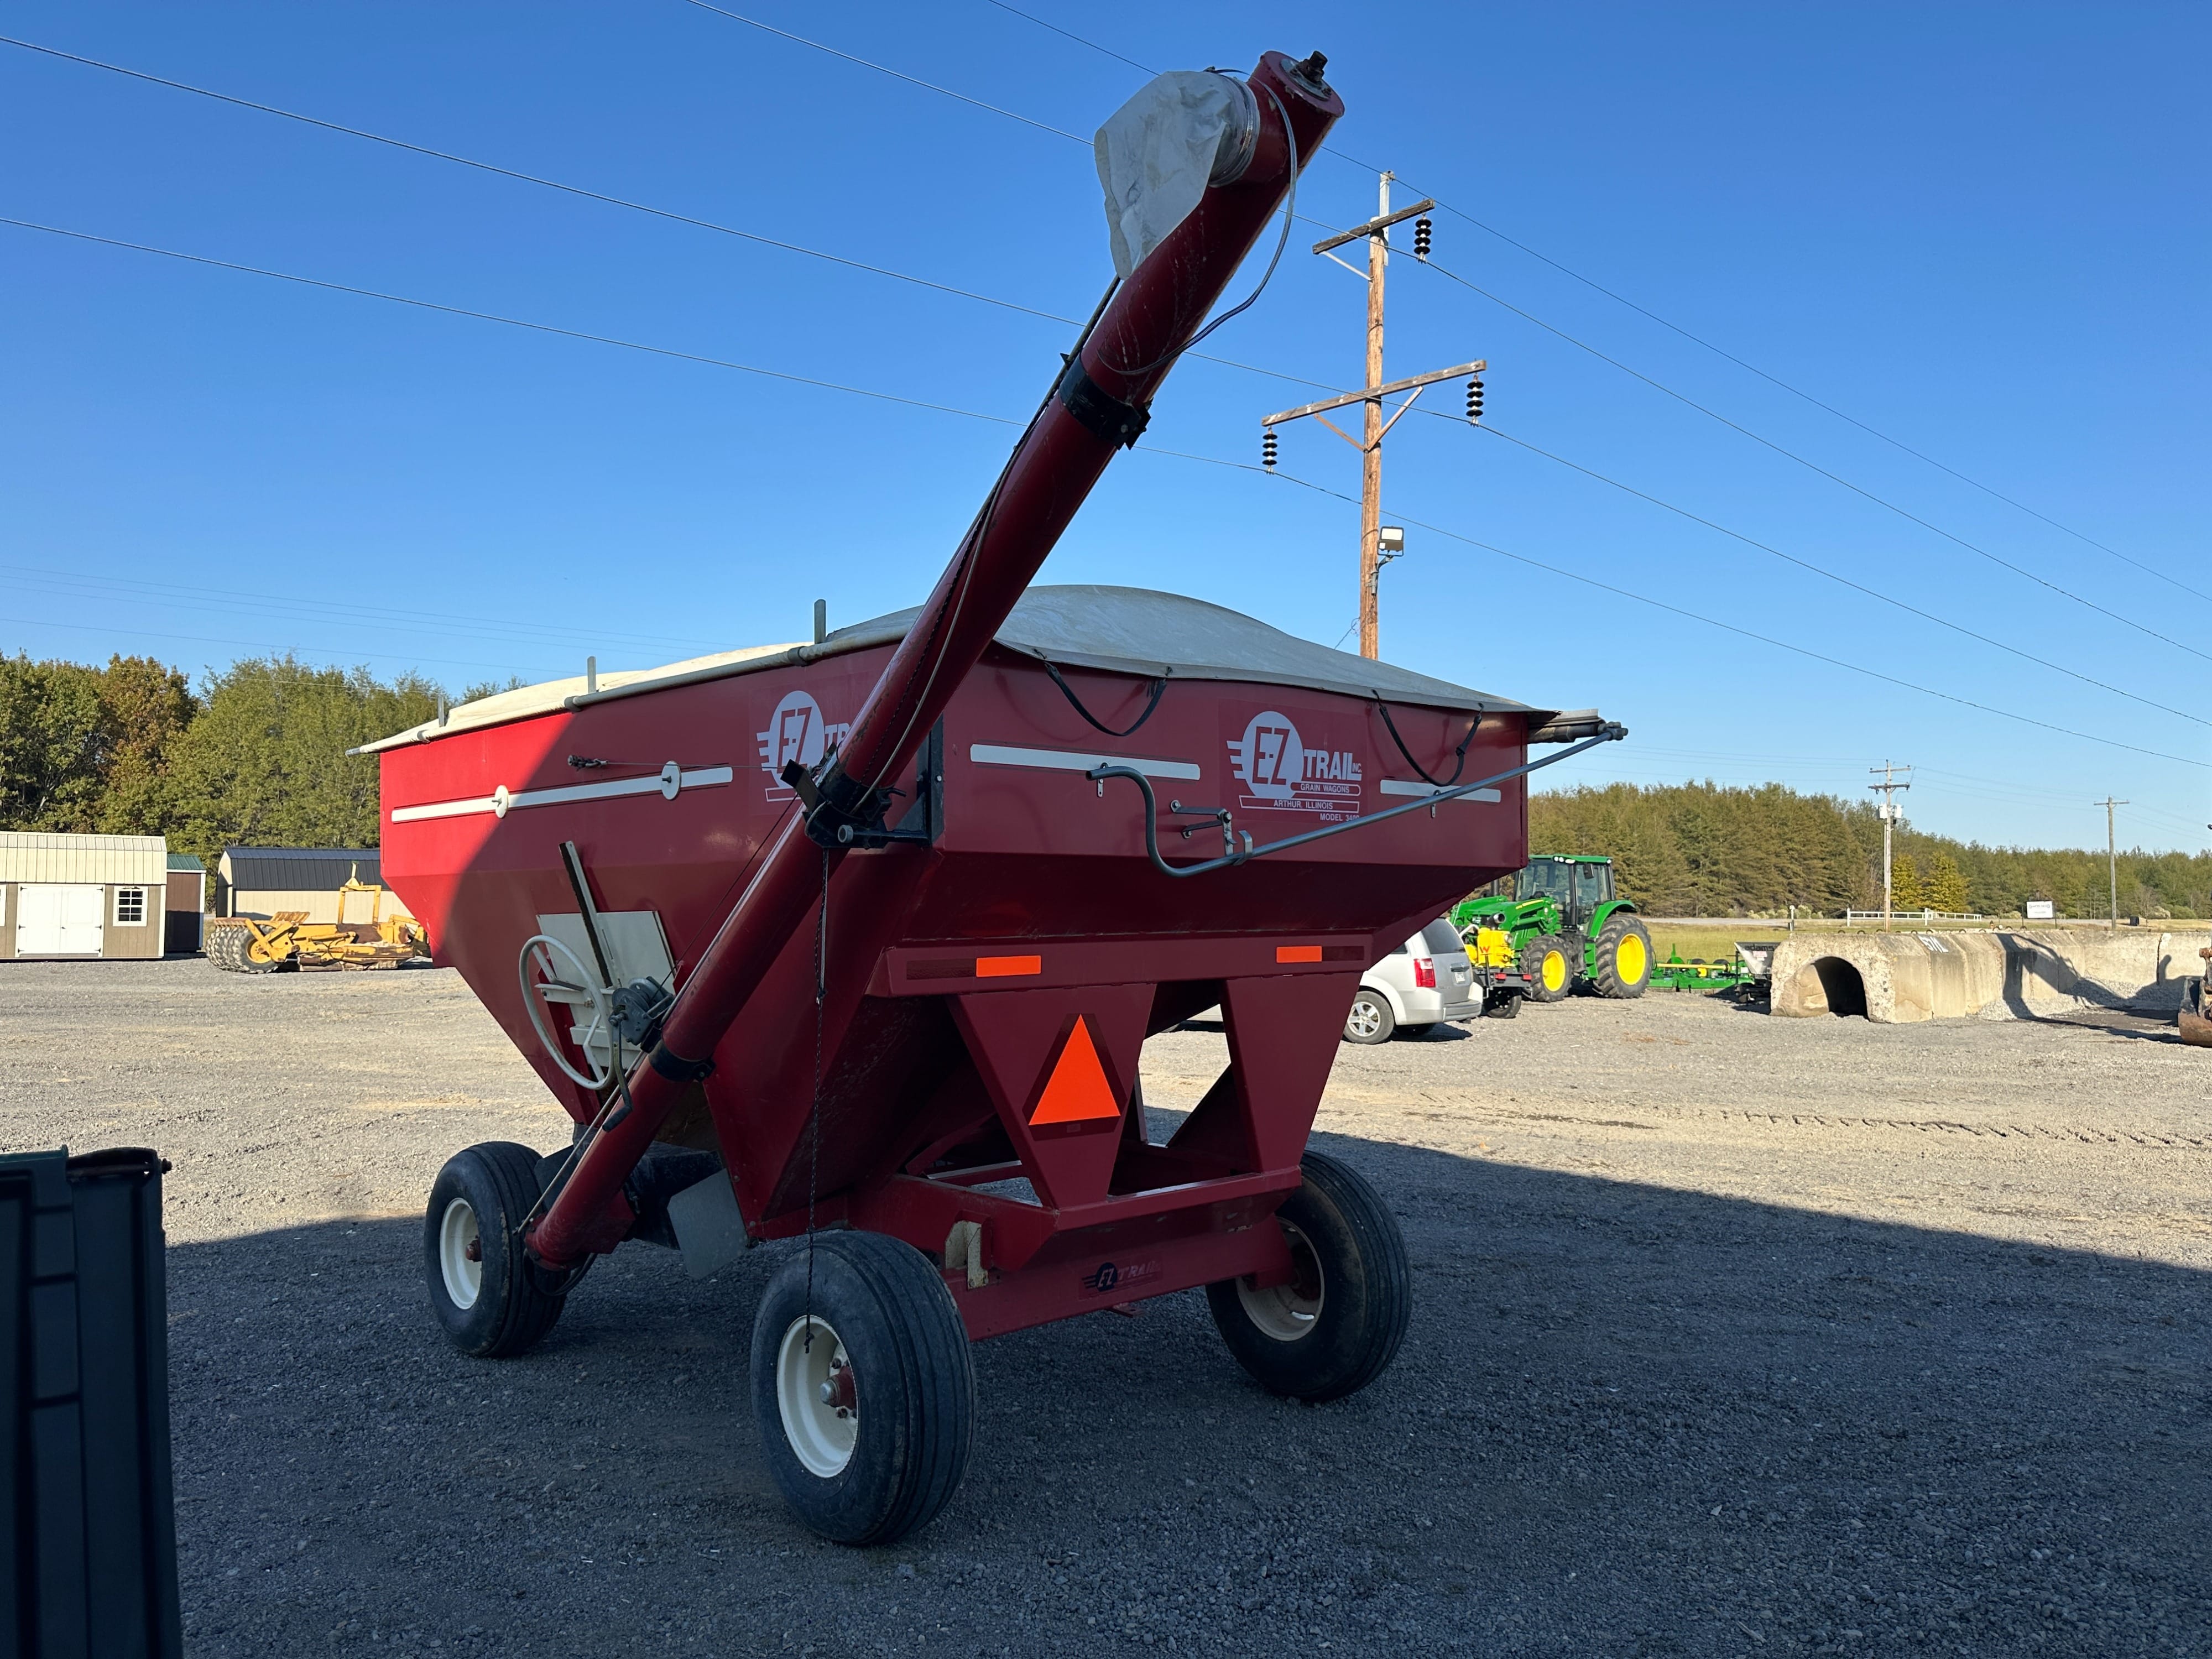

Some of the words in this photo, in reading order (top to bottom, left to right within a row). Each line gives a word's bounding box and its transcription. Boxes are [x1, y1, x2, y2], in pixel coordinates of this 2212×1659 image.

[1303, 749, 1361, 781] TRAIL
[1353, 763, 1362, 773] INC.
[1300, 783, 1321, 791] GRAIN
[1323, 785, 1349, 793] WAGONS
[1305, 801, 1333, 810] ILLINOIS
[1320, 813, 1343, 821] MODEL
